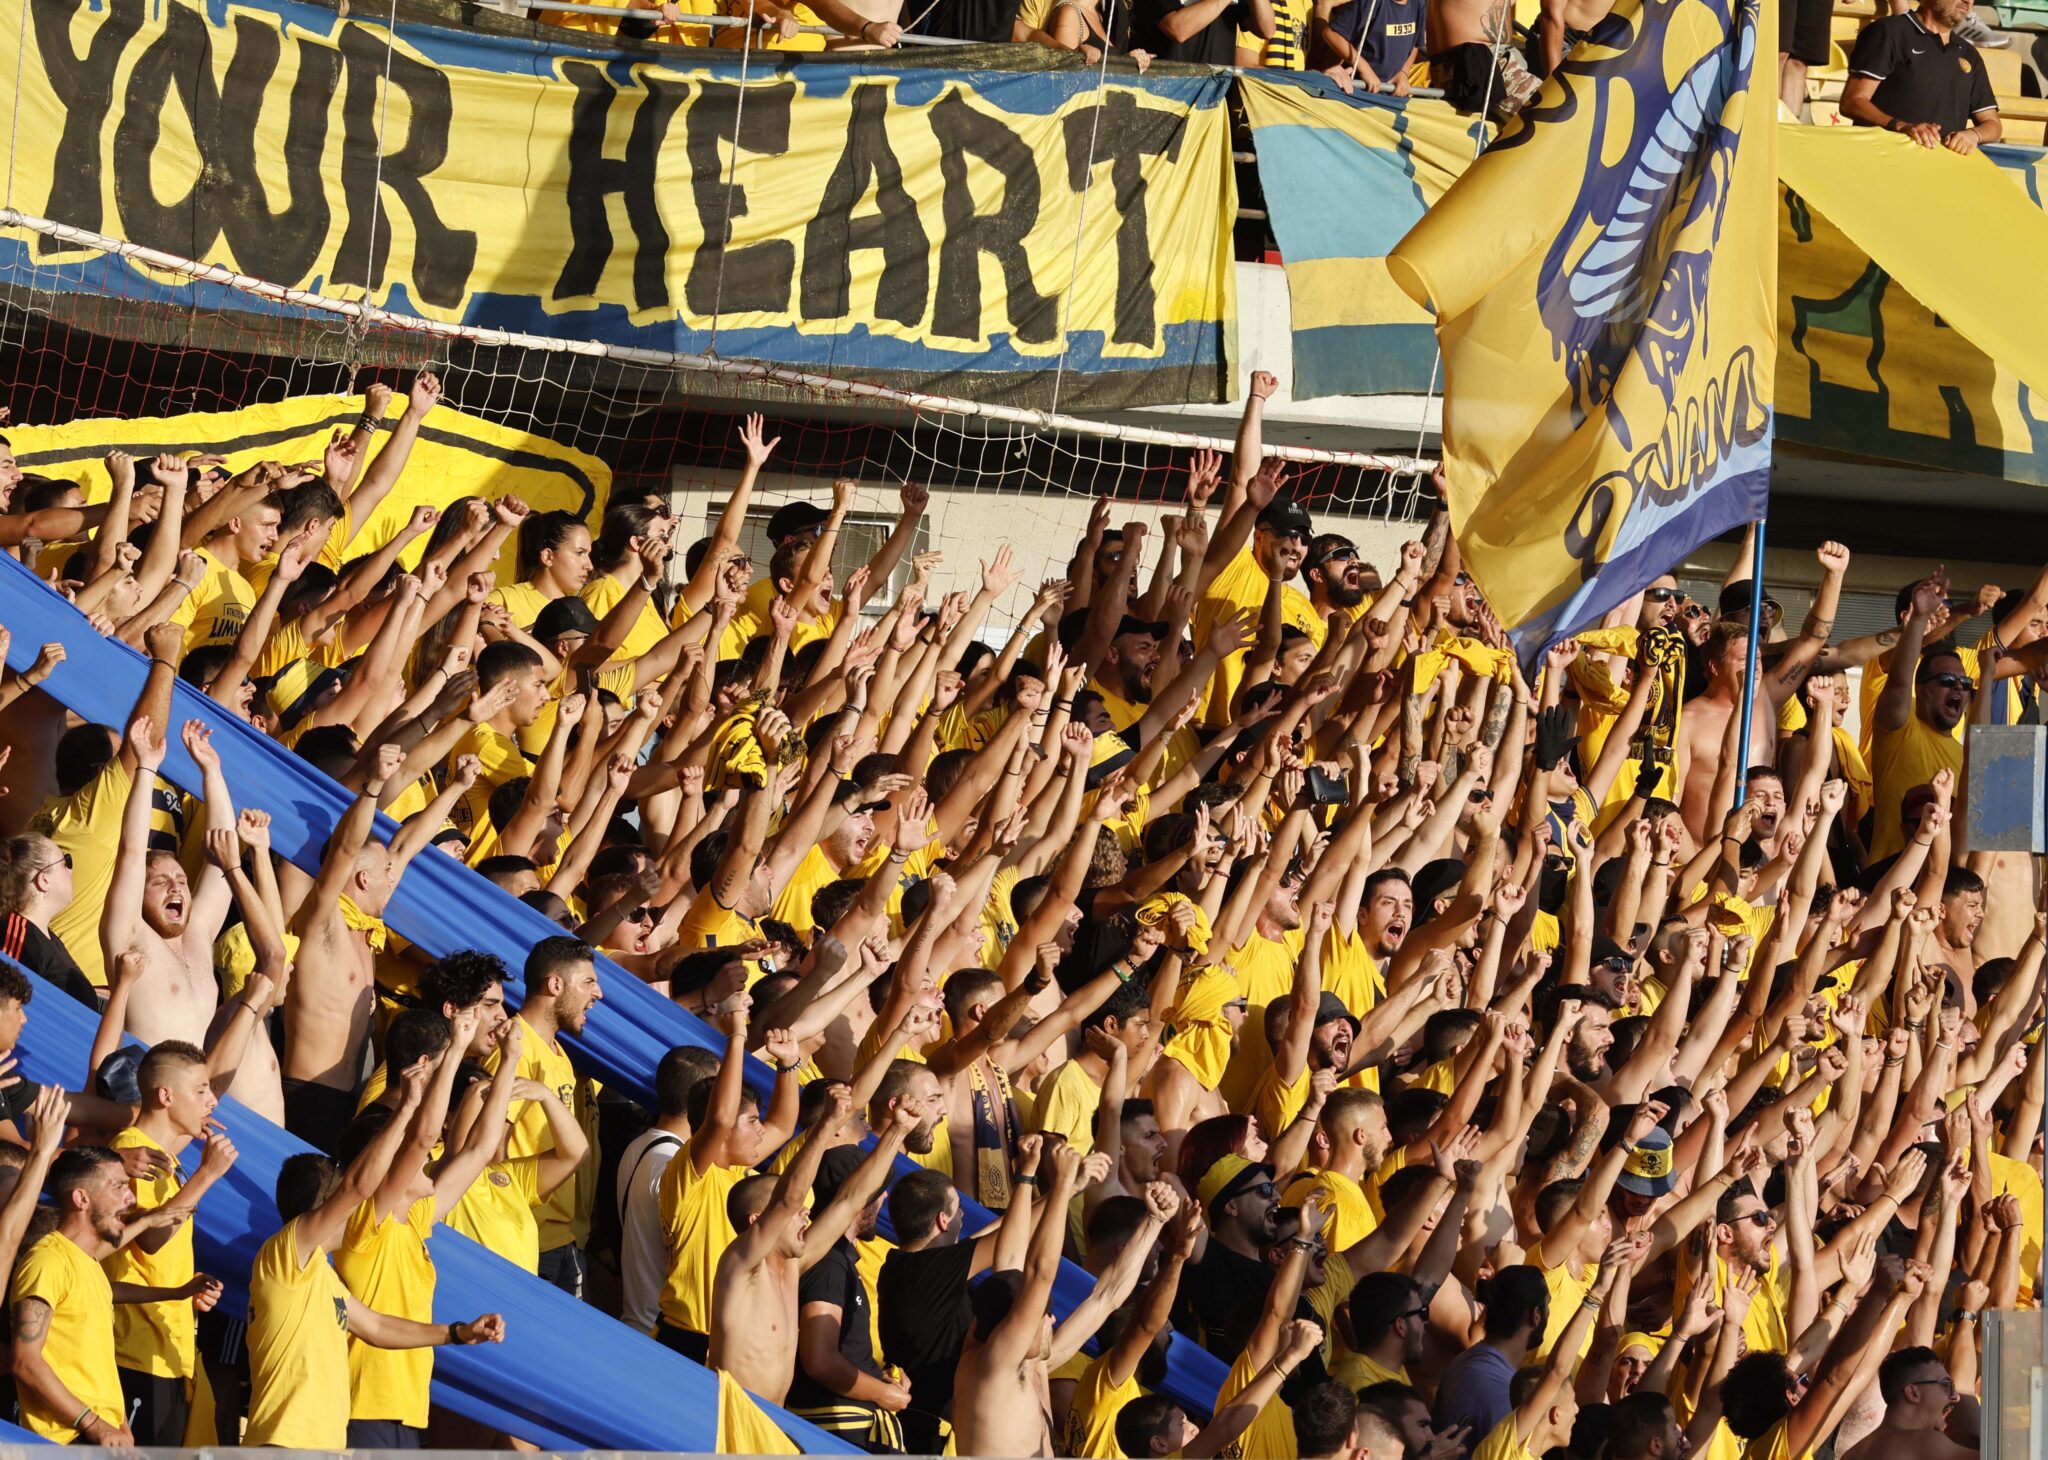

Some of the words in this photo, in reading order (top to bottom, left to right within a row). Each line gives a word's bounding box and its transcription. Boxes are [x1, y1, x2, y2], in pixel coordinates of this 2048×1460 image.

[1393, 24, 1412, 35] 1930
[33, 0, 477, 309] YOUR
[552, 59, 1189, 348] HEART
